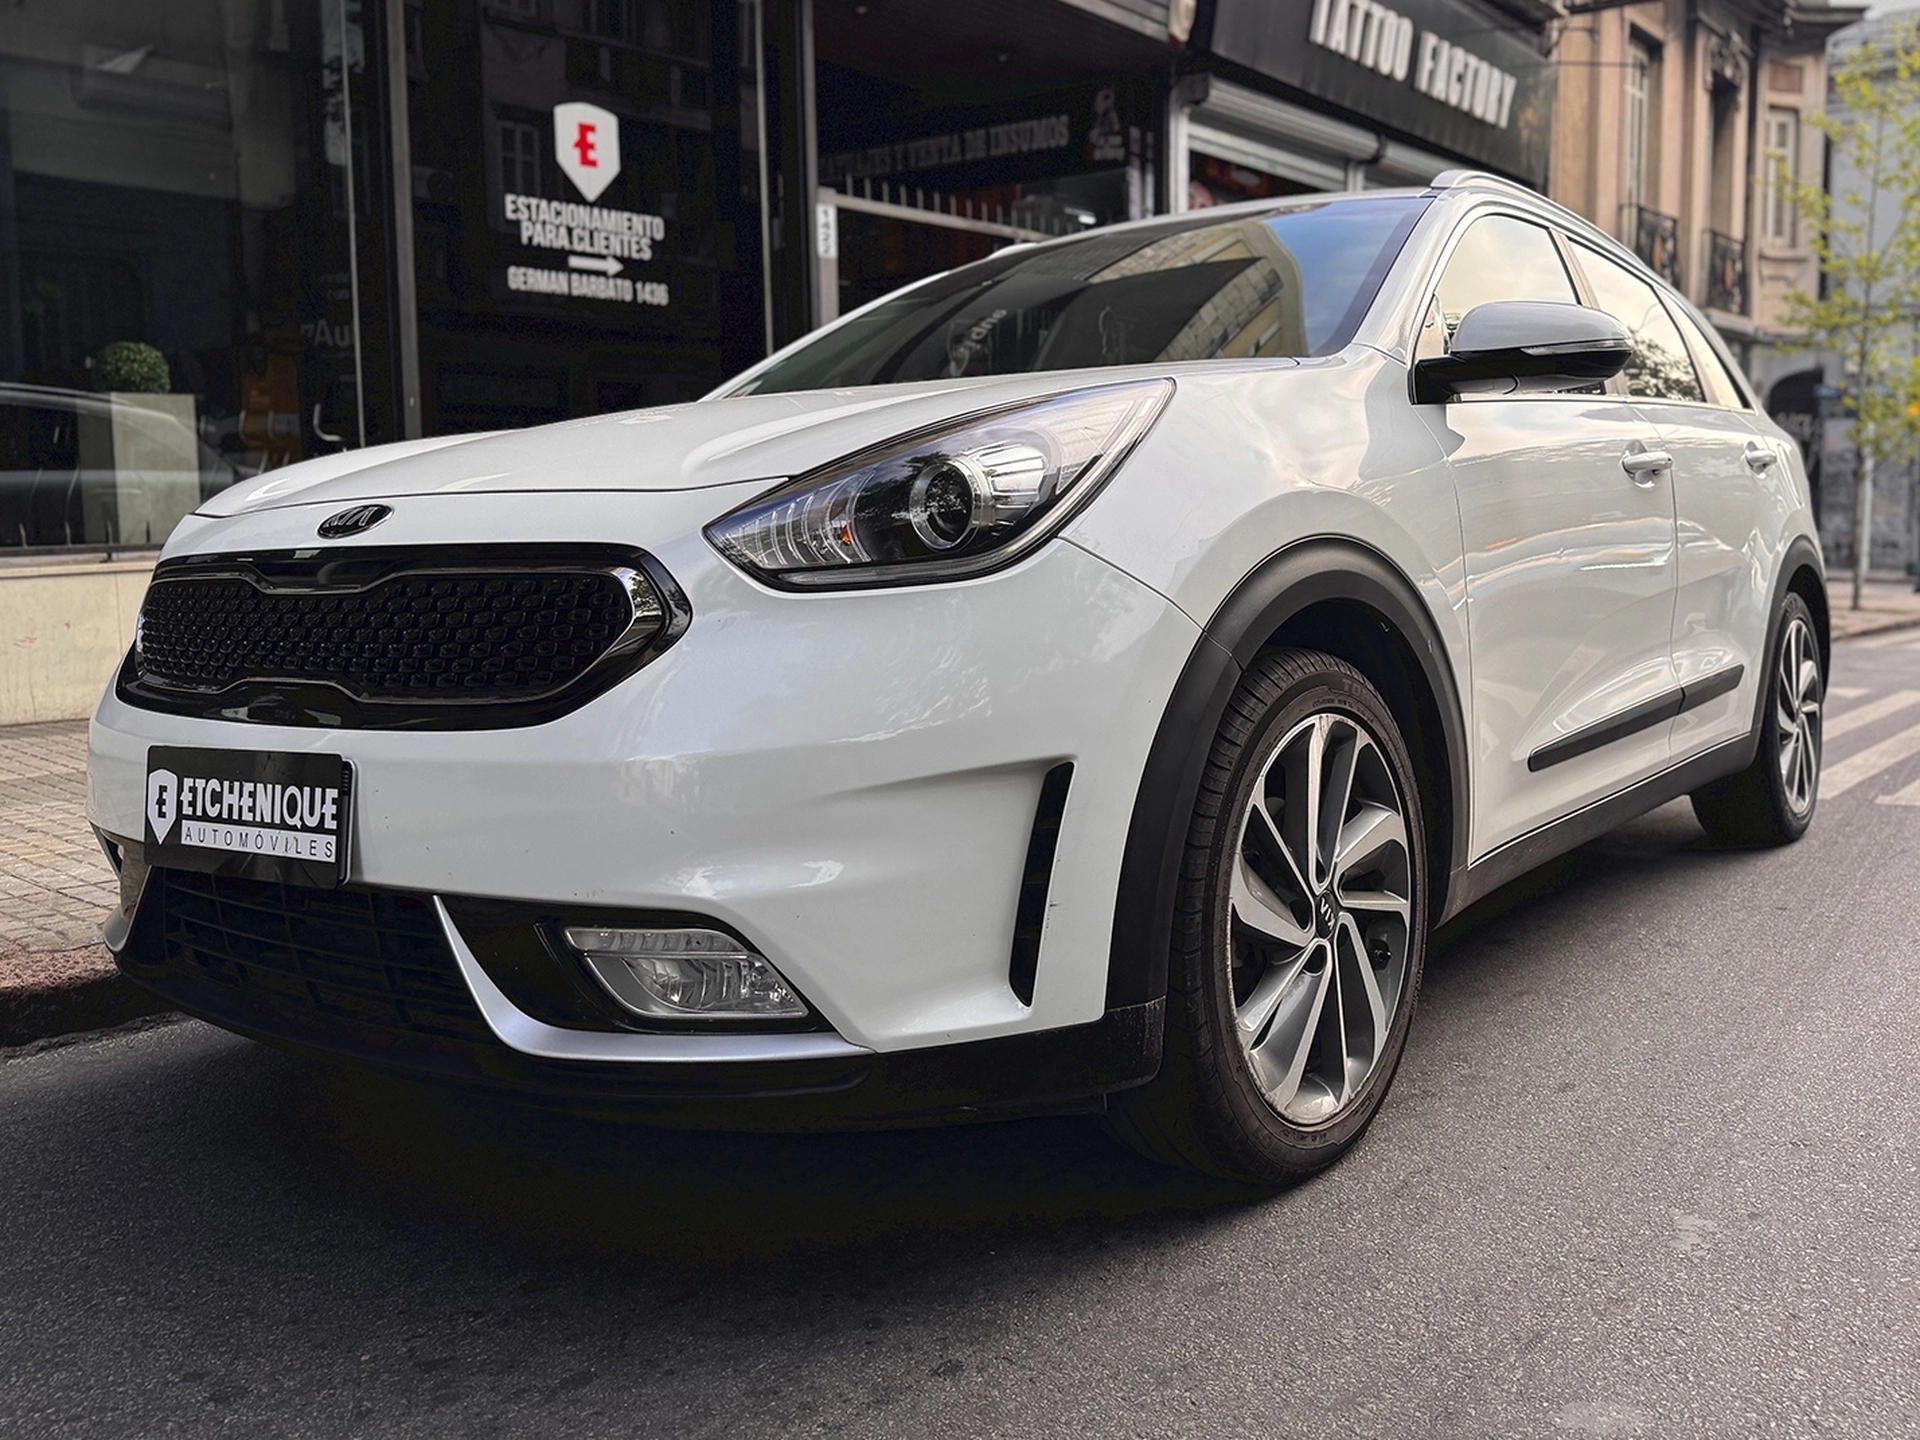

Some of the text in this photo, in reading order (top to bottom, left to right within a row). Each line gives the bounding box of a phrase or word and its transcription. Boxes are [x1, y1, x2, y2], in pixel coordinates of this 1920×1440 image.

[1414, 30, 1517, 129] FACTORY
[989, 114, 1069, 156] INSUMOS
[504, 193, 665, 241] ESTACIONAMIENTO
[520, 220, 653, 261] PARA CLIENTES
[507, 265, 569, 296] GERMAN
[570, 272, 634, 303] BARBATO
[180, 777, 339, 830] ETCHENIQUE
[185, 826, 333, 858] AUTOMÓVILES
[1320, 896, 1336, 931] KIA
